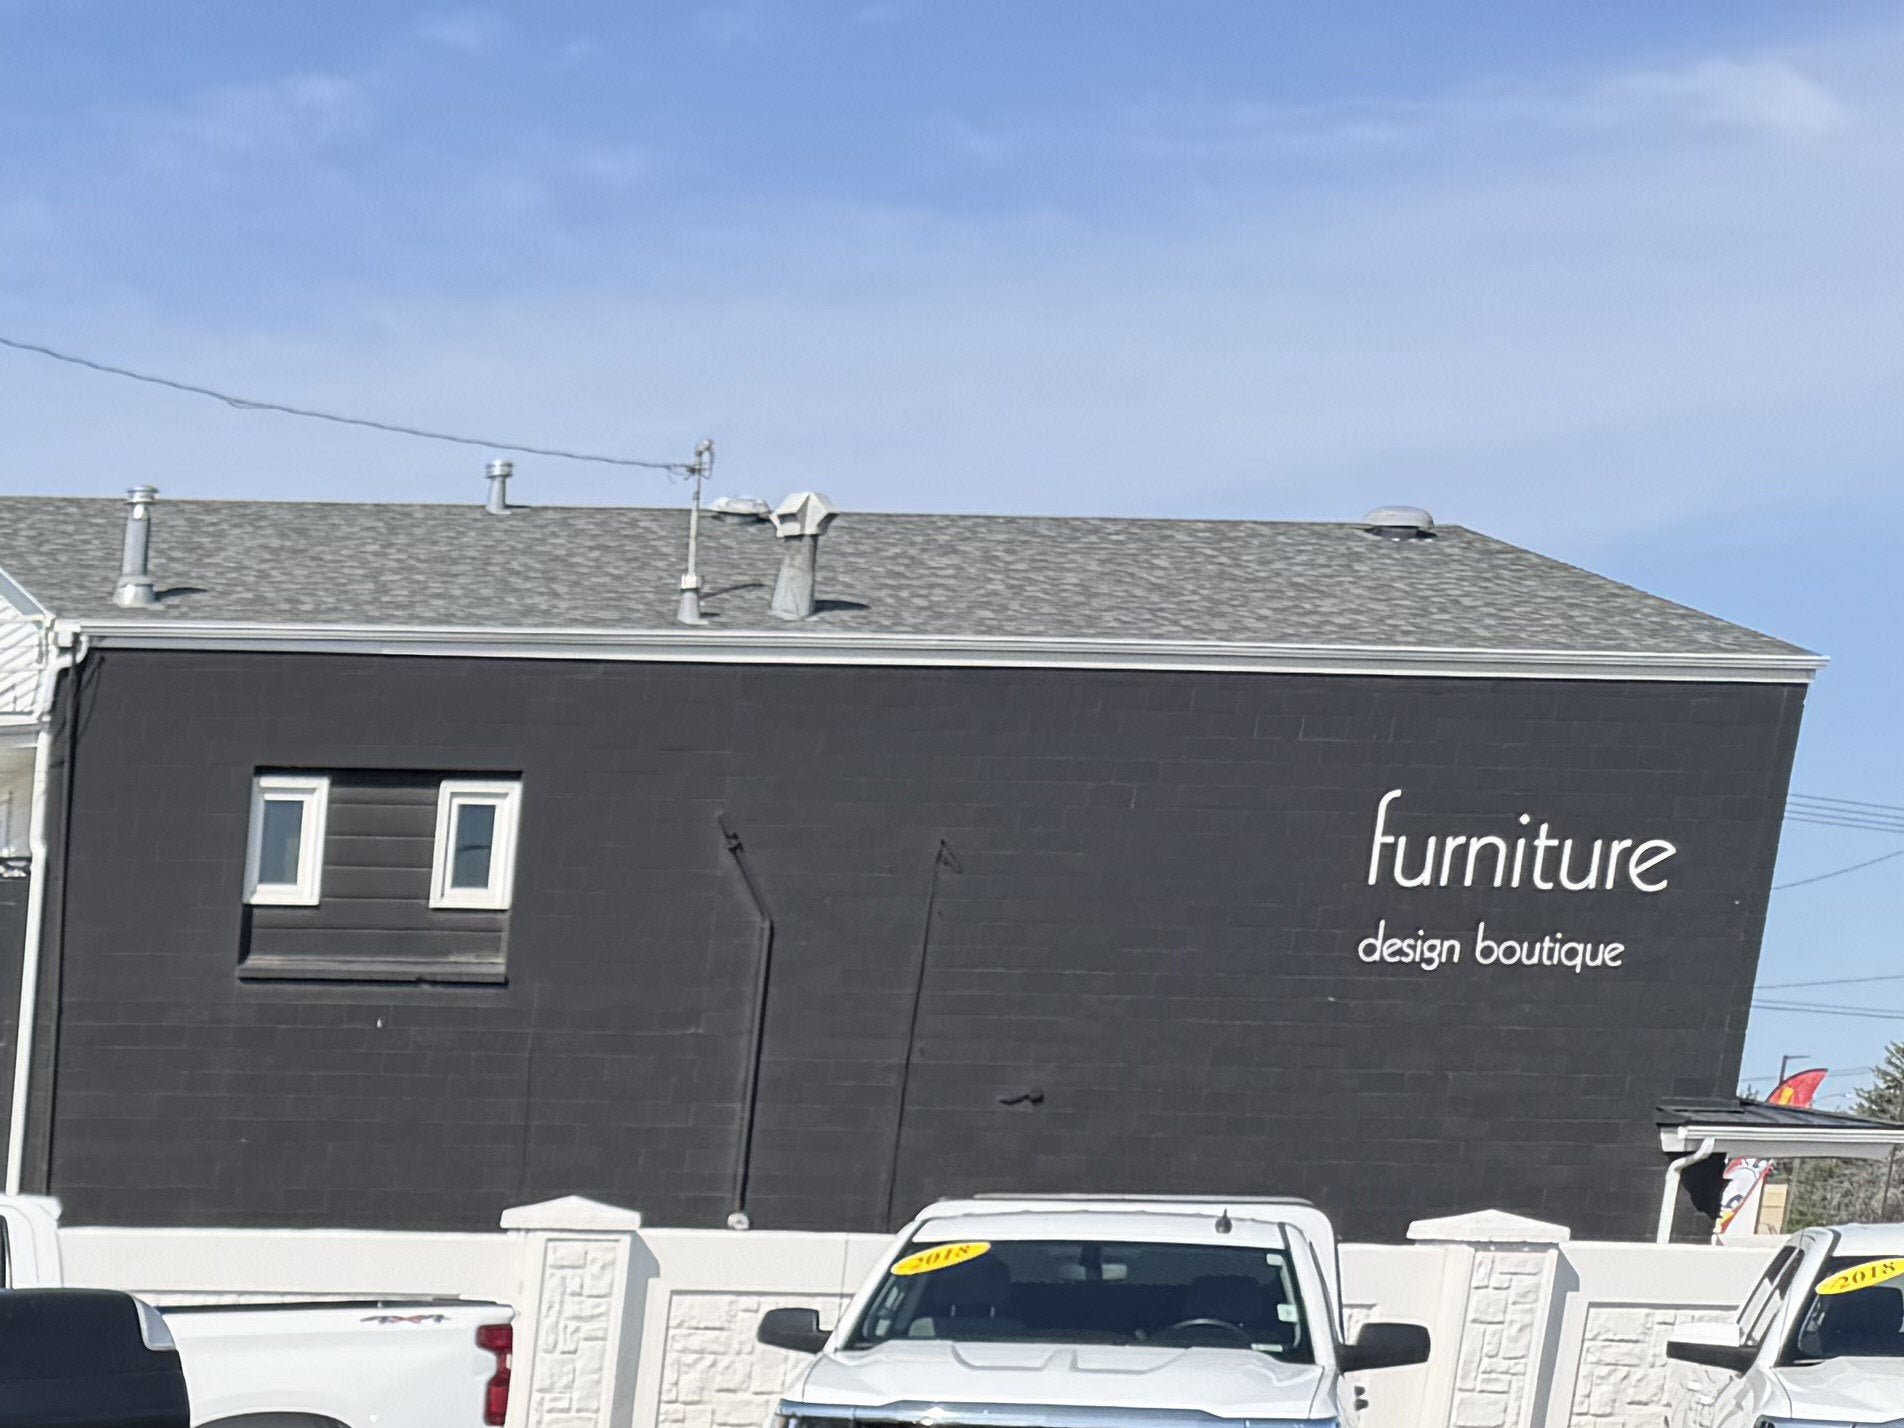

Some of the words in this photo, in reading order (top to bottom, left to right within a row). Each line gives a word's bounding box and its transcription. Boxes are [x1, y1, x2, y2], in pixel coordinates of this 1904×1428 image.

[1366, 787, 1678, 894] furniture
[1357, 918, 1461, 972] design
[1474, 921, 1626, 974] boutique
[909, 1243, 971, 1271] 2018
[1837, 1261, 1896, 1290] 2018
